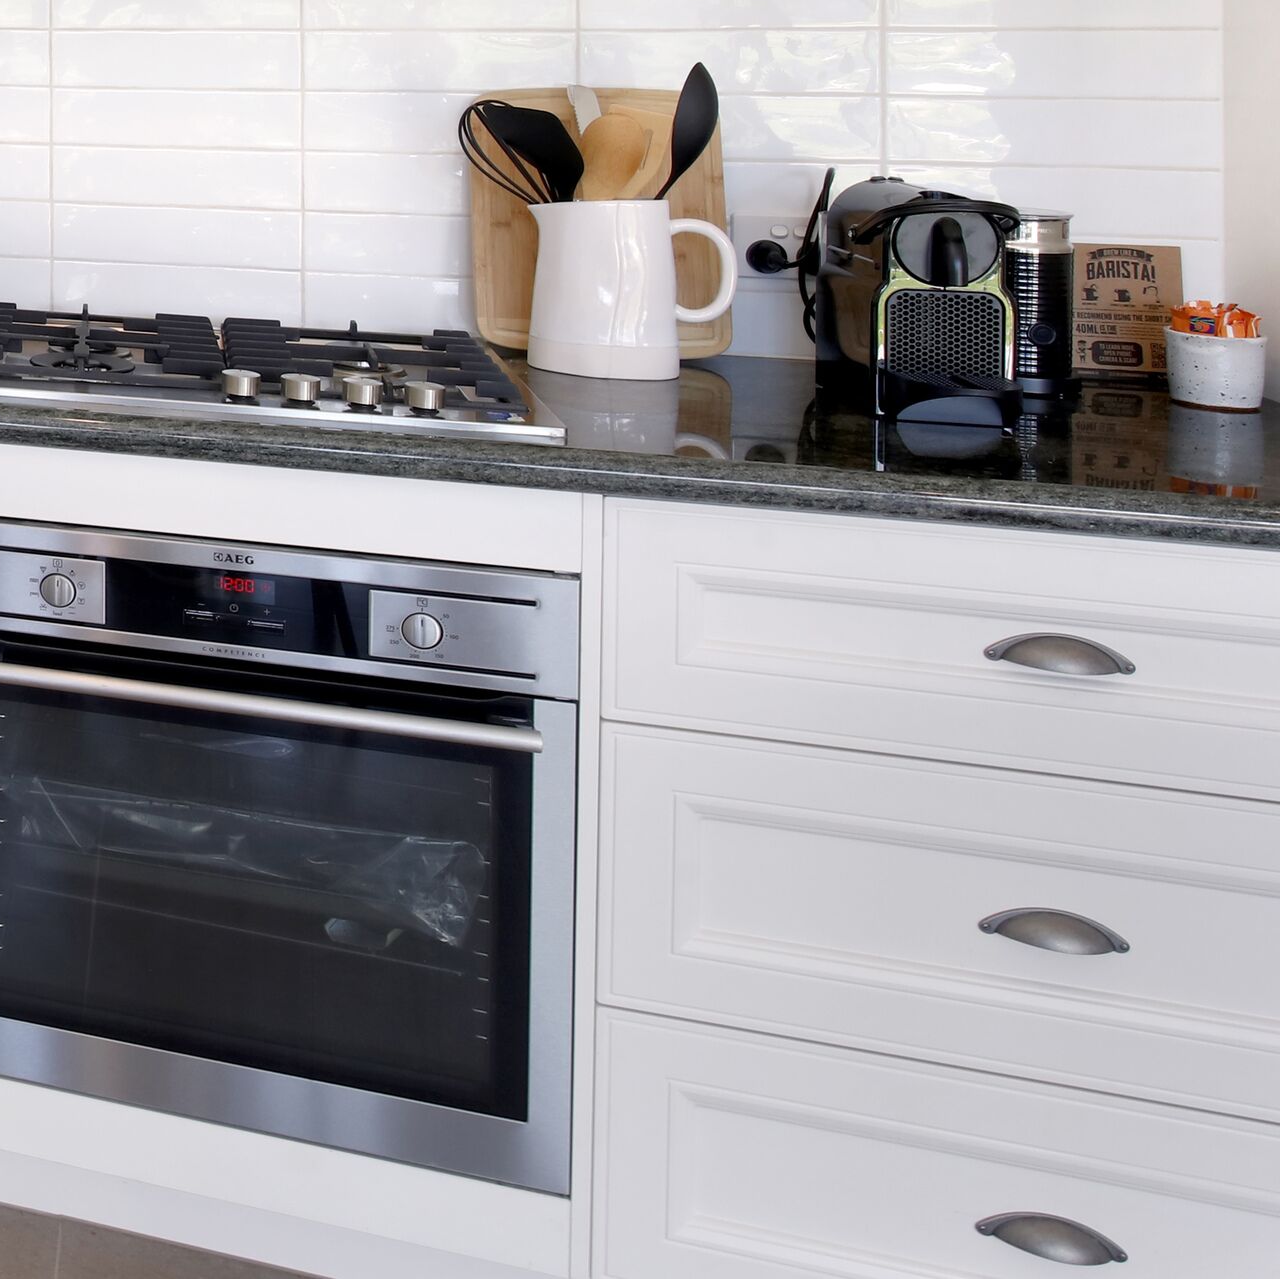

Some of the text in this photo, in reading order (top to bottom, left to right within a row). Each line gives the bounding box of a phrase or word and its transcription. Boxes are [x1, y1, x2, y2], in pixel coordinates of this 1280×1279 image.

[1086, 260, 1156, 283] BARISTA!
[1075, 323, 1100, 334] 40ML
[224, 553, 255, 565] AEG
[201, 646, 265, 659] COMPETENCE
